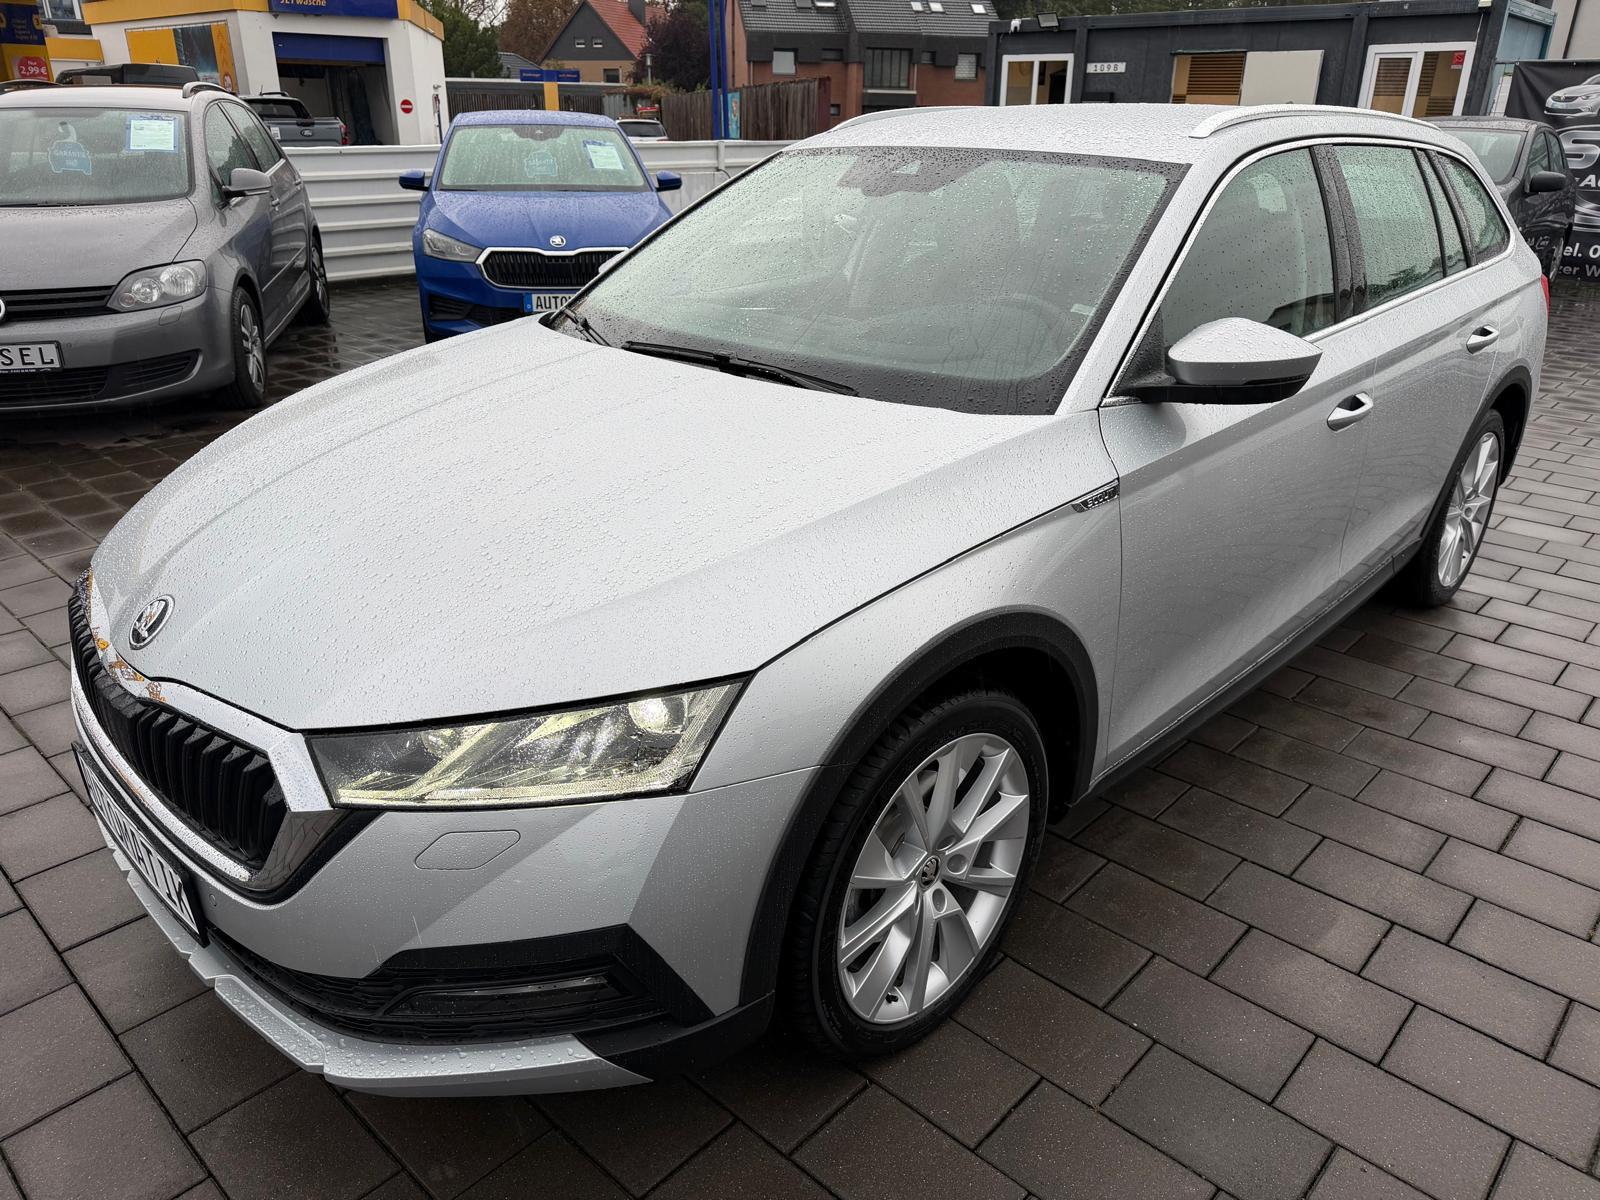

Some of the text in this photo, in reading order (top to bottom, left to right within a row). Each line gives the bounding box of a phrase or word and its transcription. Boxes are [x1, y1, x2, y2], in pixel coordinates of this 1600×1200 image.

[20, 66, 47, 76] 2,99 €
[535, 295, 573, 310] AUTO
